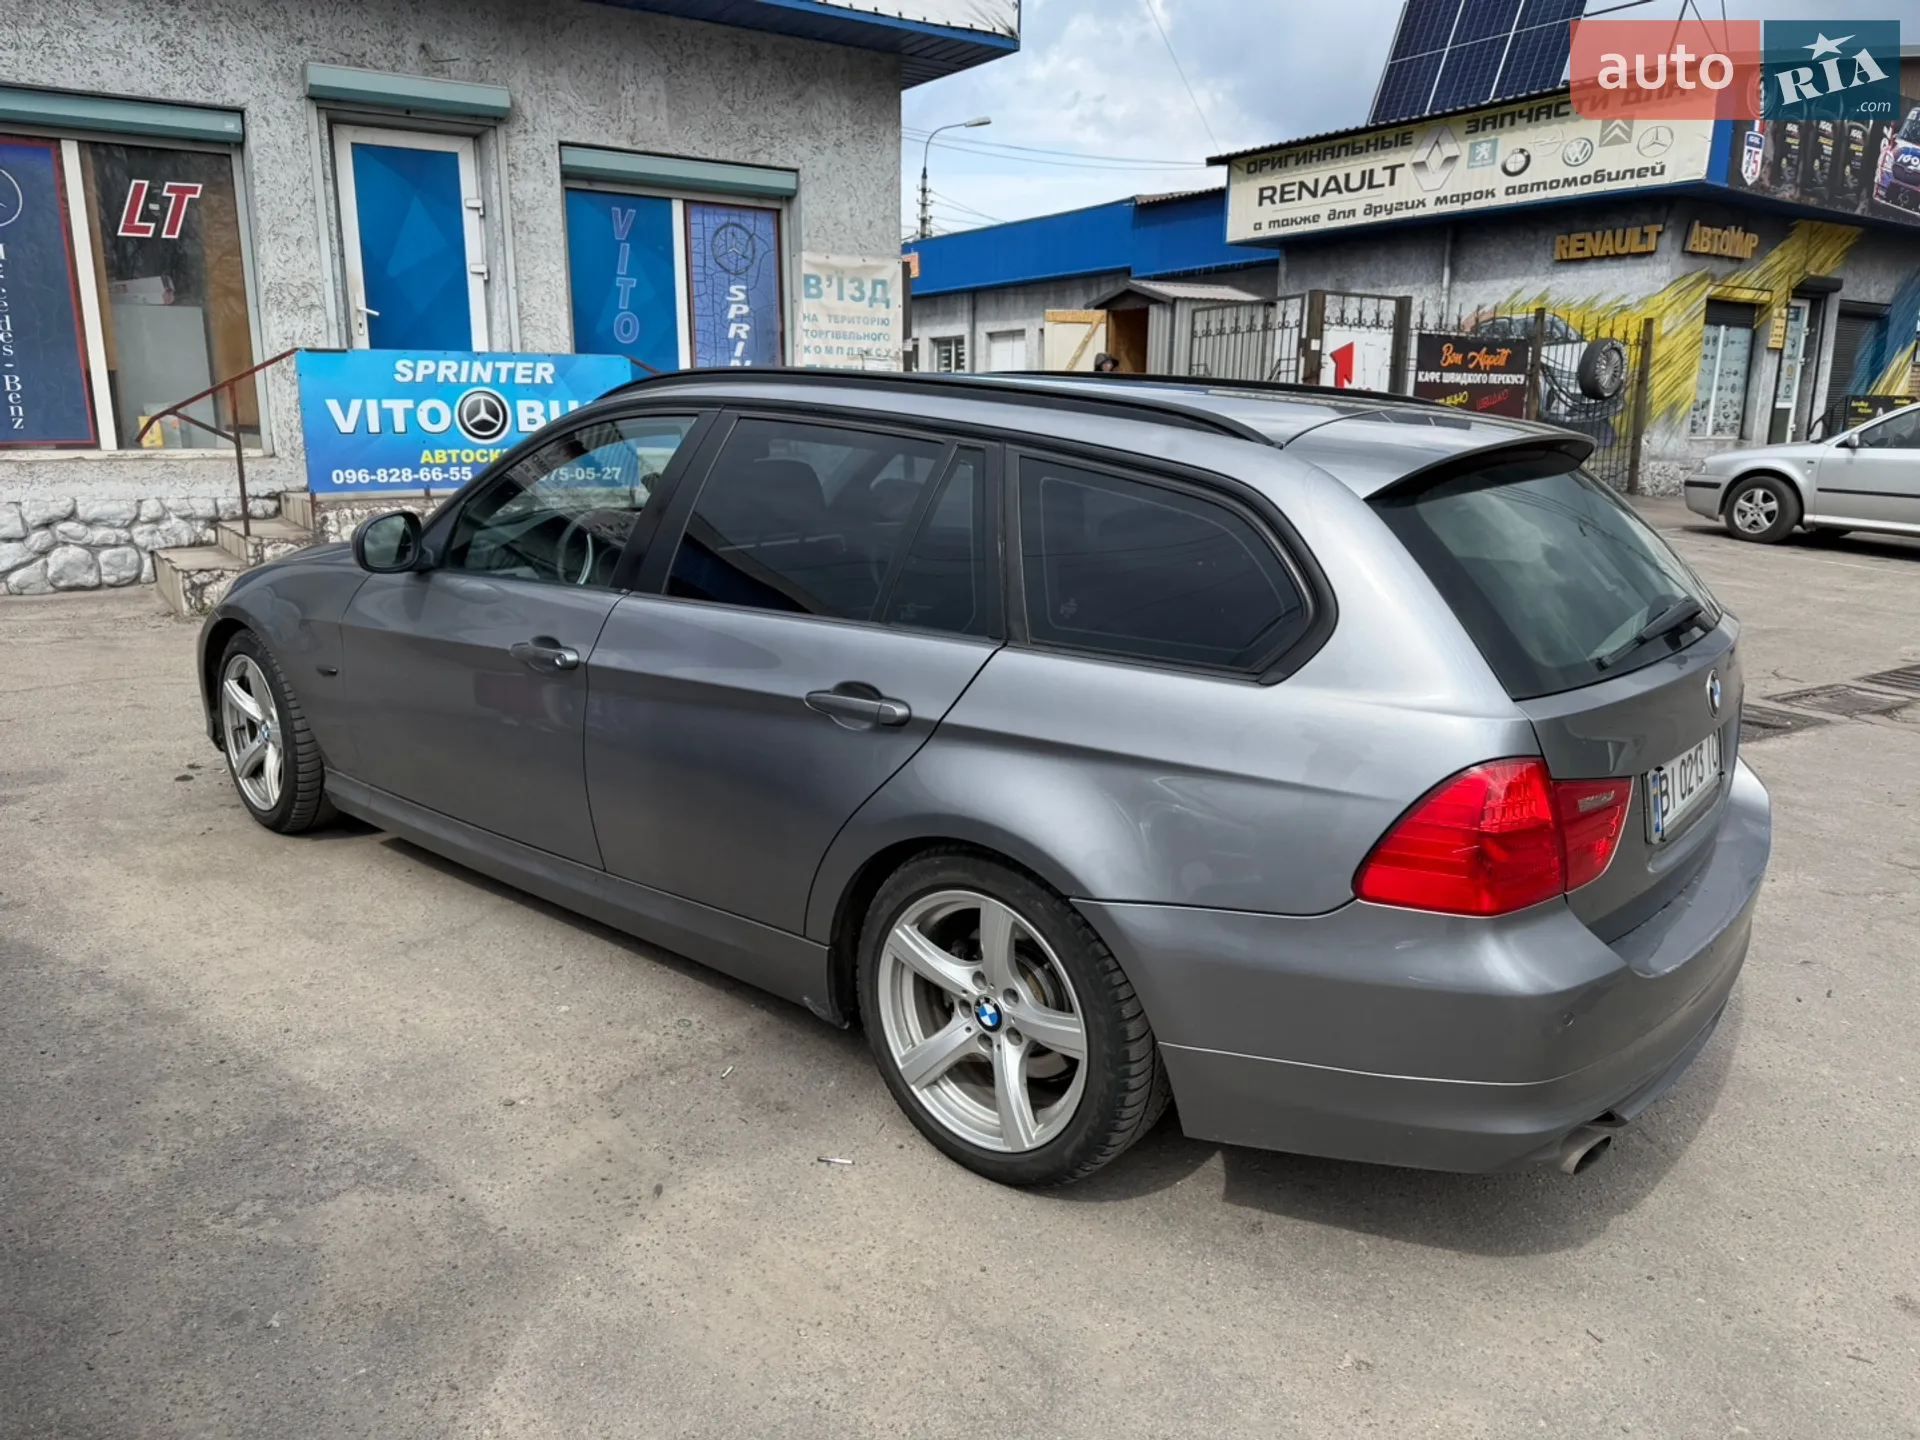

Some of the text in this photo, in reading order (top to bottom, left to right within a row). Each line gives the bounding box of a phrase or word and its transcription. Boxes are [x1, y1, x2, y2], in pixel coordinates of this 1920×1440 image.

[1246, 130, 1414, 175] ОРИГИНАЛЬНЫЕ
[1253, 220, 1263, 231] а
[1268, 213, 1321, 230] также
[1327, 207, 1356, 220] для
[1363, 197, 1427, 218] других
[1434, 185, 1497, 207] марок
[1504, 160, 1666, 197] автомобилей
[1257, 162, 1405, 207] RENAULT
[117, 179, 203, 239] LT
[1554, 223, 1664, 261] RENAULT
[611, 206, 640, 344] VITO
[802, 313, 891, 327] НА ТЕРИТОРІЮ
[803, 328, 891, 342] ТОРГІВЕЛЬНОГО
[394, 359, 556, 385] SPRINTER
[1417, 371, 1441, 382] КАФЕ
[1442, 372, 1488, 386] ШВИДКОГО
[325, 398, 596, 434] VITO BU
[420, 448, 508, 464] АВТОСК
[332, 466, 473, 484] 096-828-66-55
